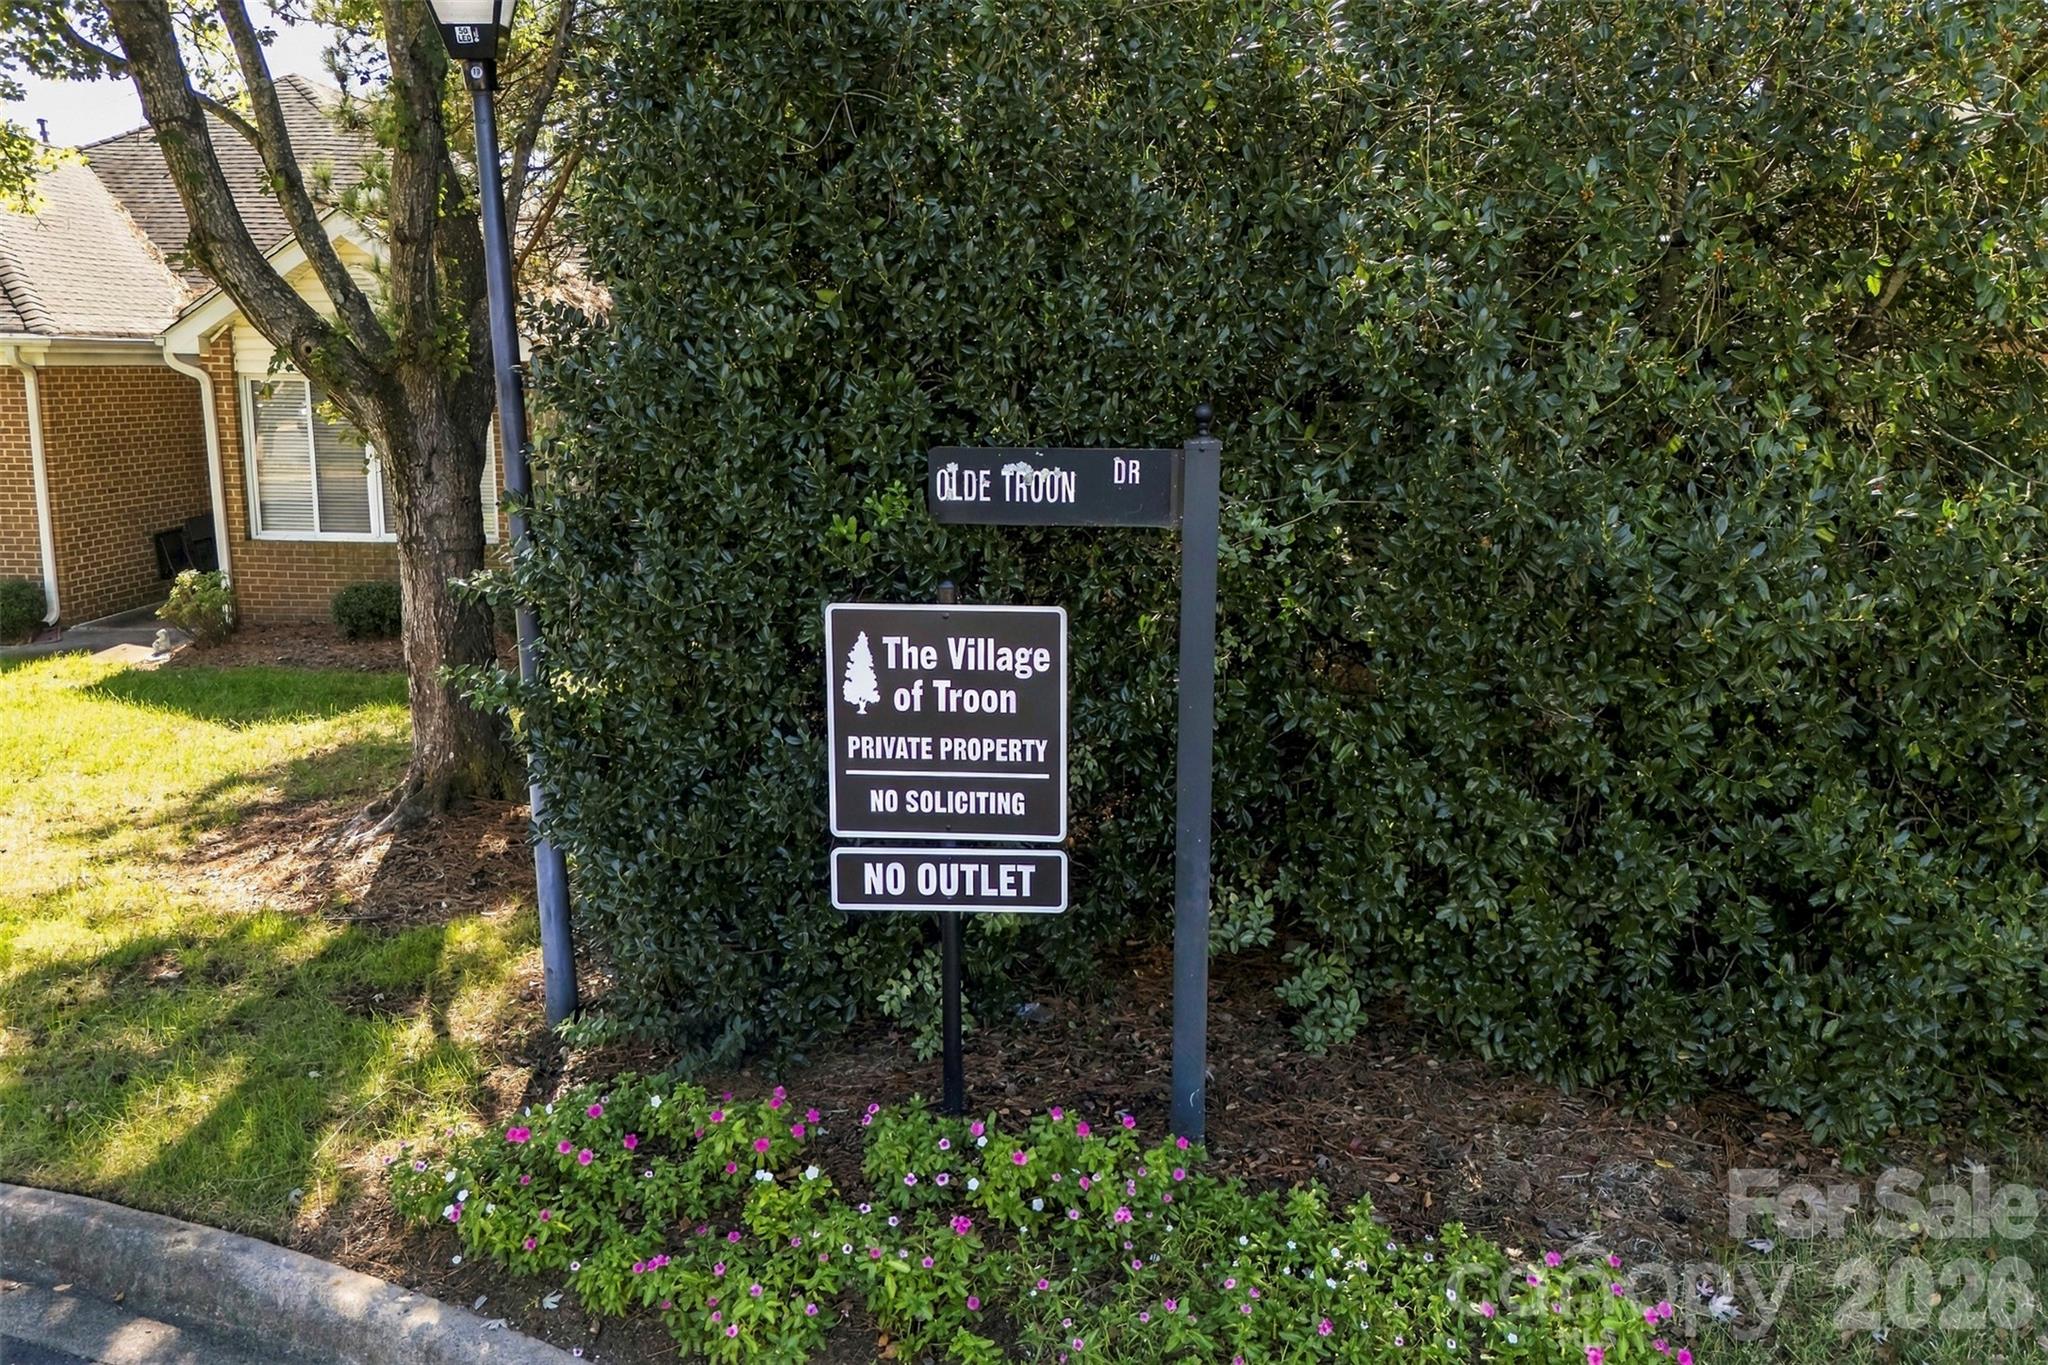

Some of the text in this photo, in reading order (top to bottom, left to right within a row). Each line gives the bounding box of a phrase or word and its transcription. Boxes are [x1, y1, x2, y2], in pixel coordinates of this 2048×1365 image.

[936, 459, 1141, 503] OLDE TROON DR
[882, 636, 1051, 679] The Village
[894, 679, 1017, 714] of Troon
[847, 736, 1048, 763] PRIVATE PROPERTY
[870, 789, 1026, 816] NO SOLICITING
[864, 862, 1036, 897] NO OUTLET
